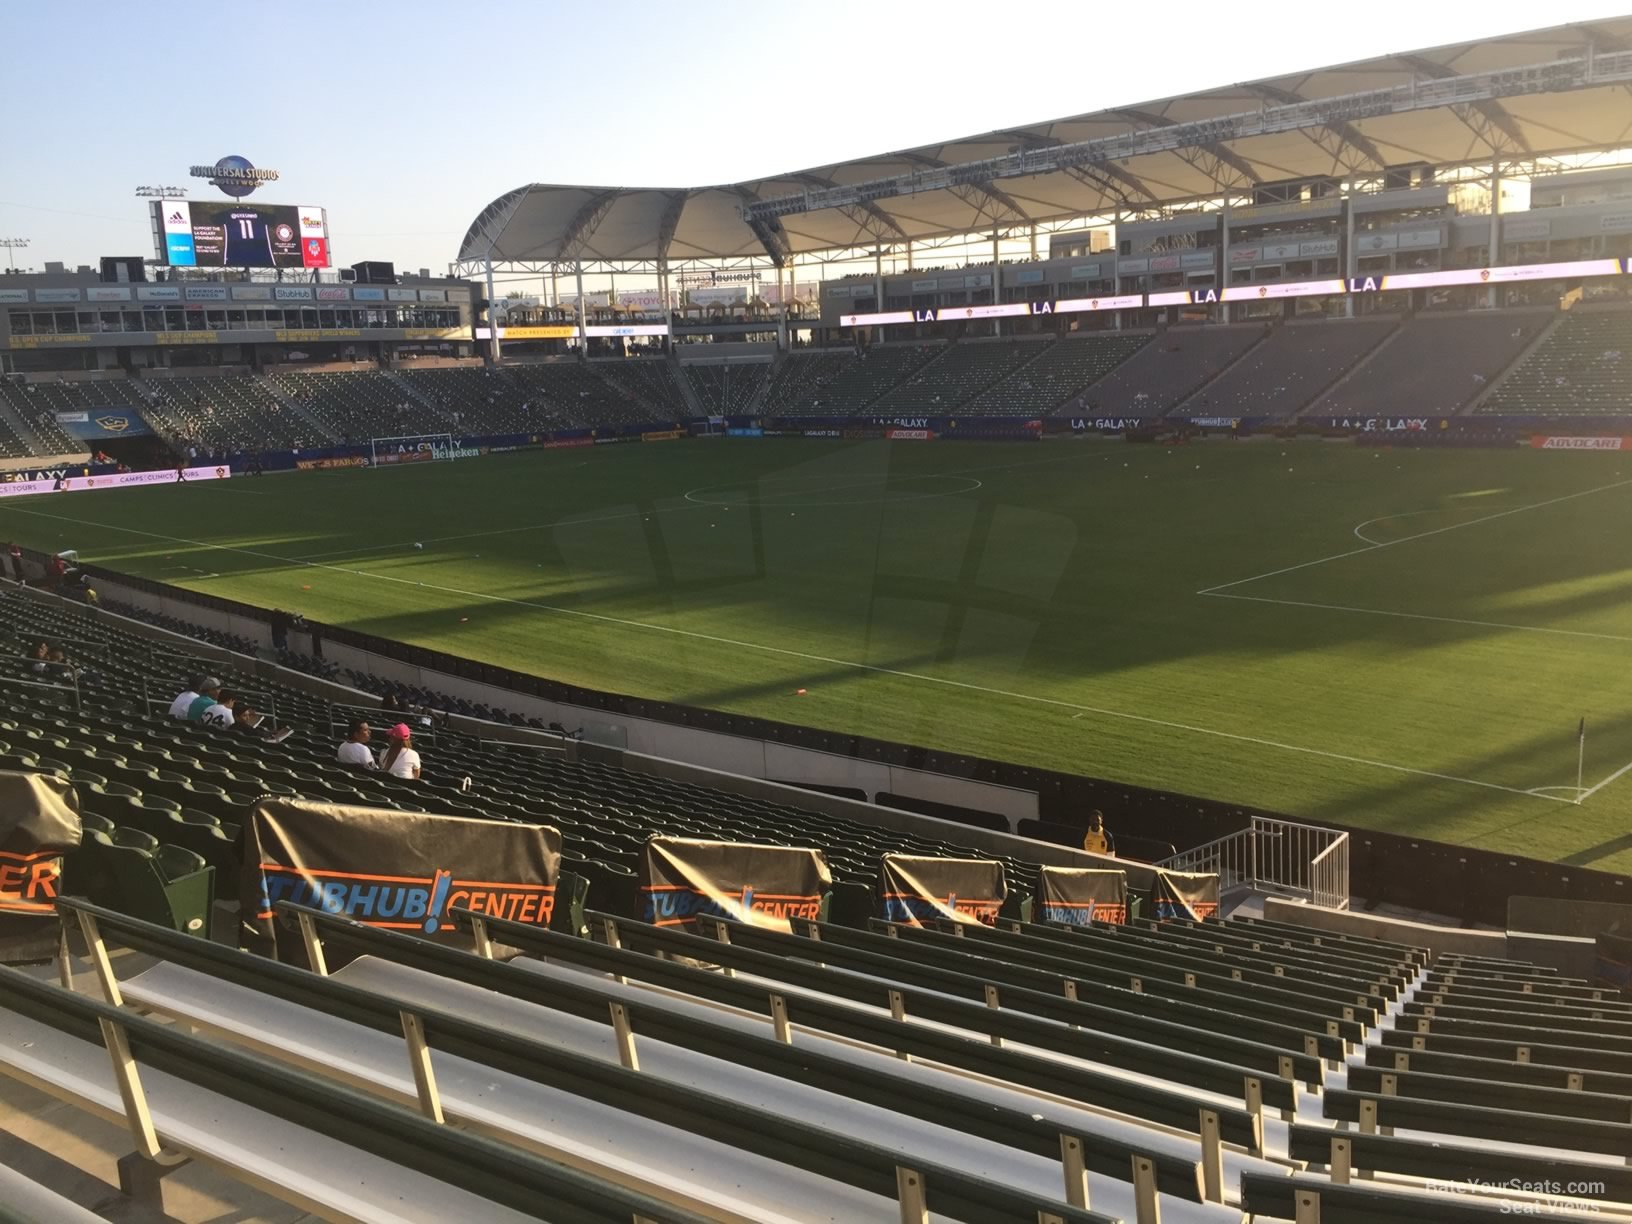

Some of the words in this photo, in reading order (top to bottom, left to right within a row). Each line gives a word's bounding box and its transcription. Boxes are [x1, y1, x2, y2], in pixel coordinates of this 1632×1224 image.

[192, 166, 245, 178] UNIVERSAL
[246, 169, 279, 181] STUDIOS
[240, 220, 254, 239] 11
[1302, 244, 1336, 254] StubHub
[1351, 277, 1378, 292] LA
[277, 289, 310, 298] StubHub
[1194, 289, 1217, 304] LA
[1033, 302, 1052, 314] LA
[916, 310, 934, 322] LA
[894, 419, 928, 427] GALAXY
[1072, 420, 1085, 429] LA
[1096, 419, 1140, 429] GALAXY
[1545, 439, 1620, 448] ADVOCARE
[433, 448, 480, 459] Heineken
[148, 473, 176, 481] CLINICS
[13, 484, 37, 492] TOURS
[447, 890, 555, 924] CENTER
[1093, 909, 1126, 926] CENTER
